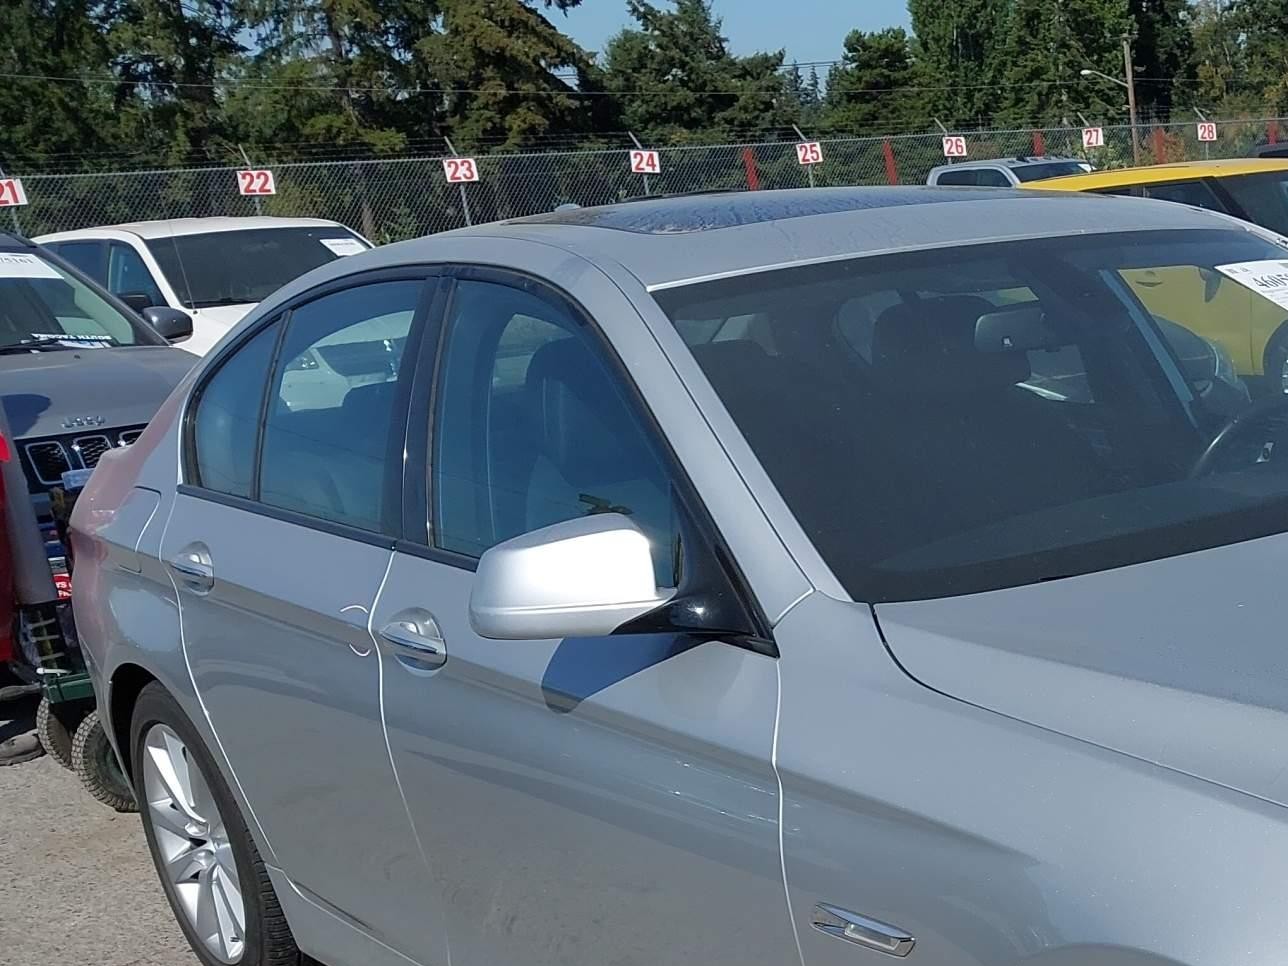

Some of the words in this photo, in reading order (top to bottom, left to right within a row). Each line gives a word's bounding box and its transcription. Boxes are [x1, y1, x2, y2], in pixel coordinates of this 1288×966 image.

[1085, 129, 1099, 146] 27
[1199, 124, 1215, 140] 28
[799, 143, 820, 163] 25
[944, 138, 965, 155] 26
[447, 159, 475, 181] 23
[633, 152, 657, 171] 24
[240, 171, 272, 193] 22
